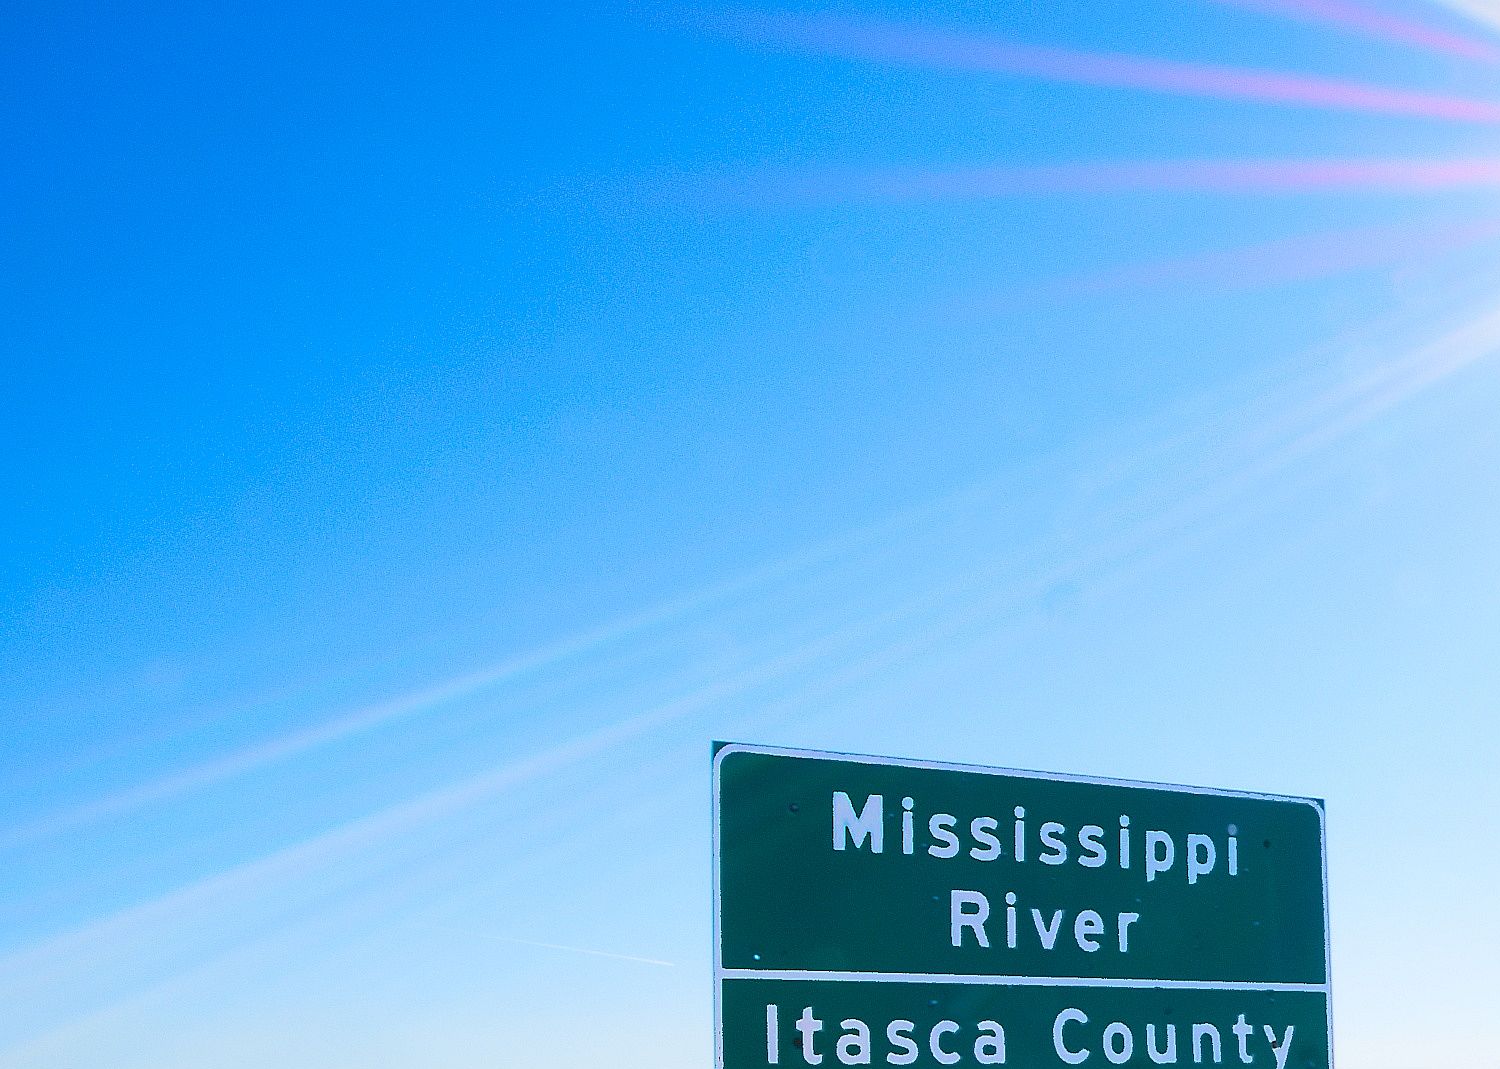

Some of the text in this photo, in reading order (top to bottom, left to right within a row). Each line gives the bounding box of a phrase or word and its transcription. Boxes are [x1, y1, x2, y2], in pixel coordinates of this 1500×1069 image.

[832, 791, 1239, 884] Mississippi
[950, 890, 1140, 953] River
[766, 1003, 1006, 1066] Itasca
